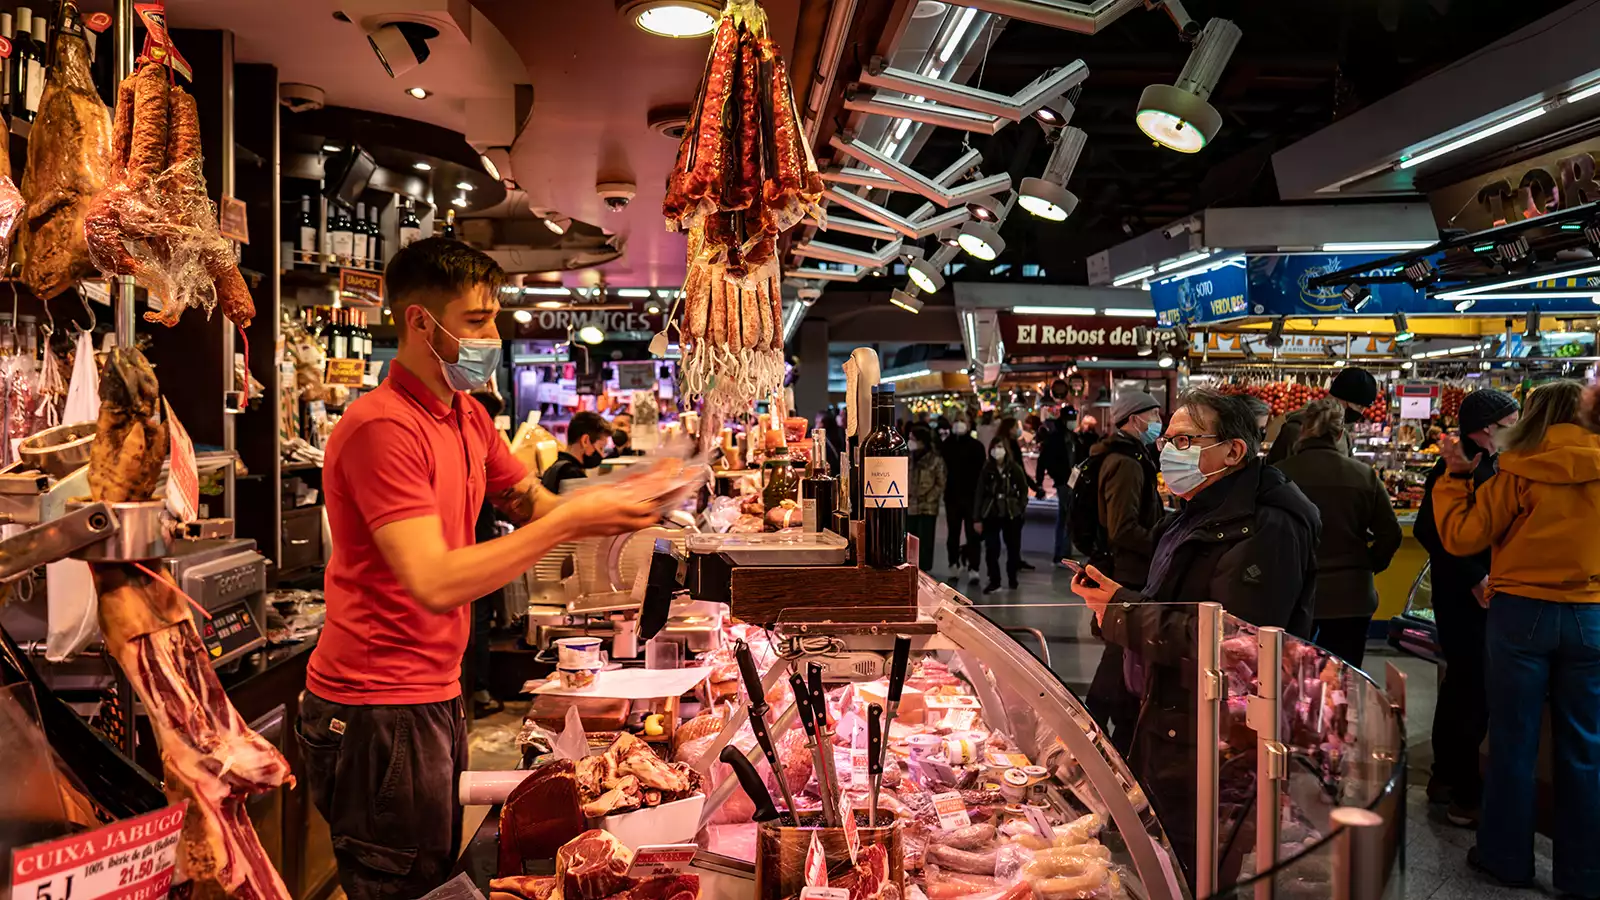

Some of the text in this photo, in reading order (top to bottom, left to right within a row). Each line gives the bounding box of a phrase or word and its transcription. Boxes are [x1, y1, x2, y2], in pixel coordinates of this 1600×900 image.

[1196, 280, 1213, 298] SOTO
[1210, 294, 1245, 315] VERDURES
[1017, 324, 1037, 344] El
[1041, 325, 1105, 345] Rebost
[16, 809, 183, 876] CUIXA JABUGO
[131, 848, 141, 861] de
[118, 858, 154, 887] 21.50
